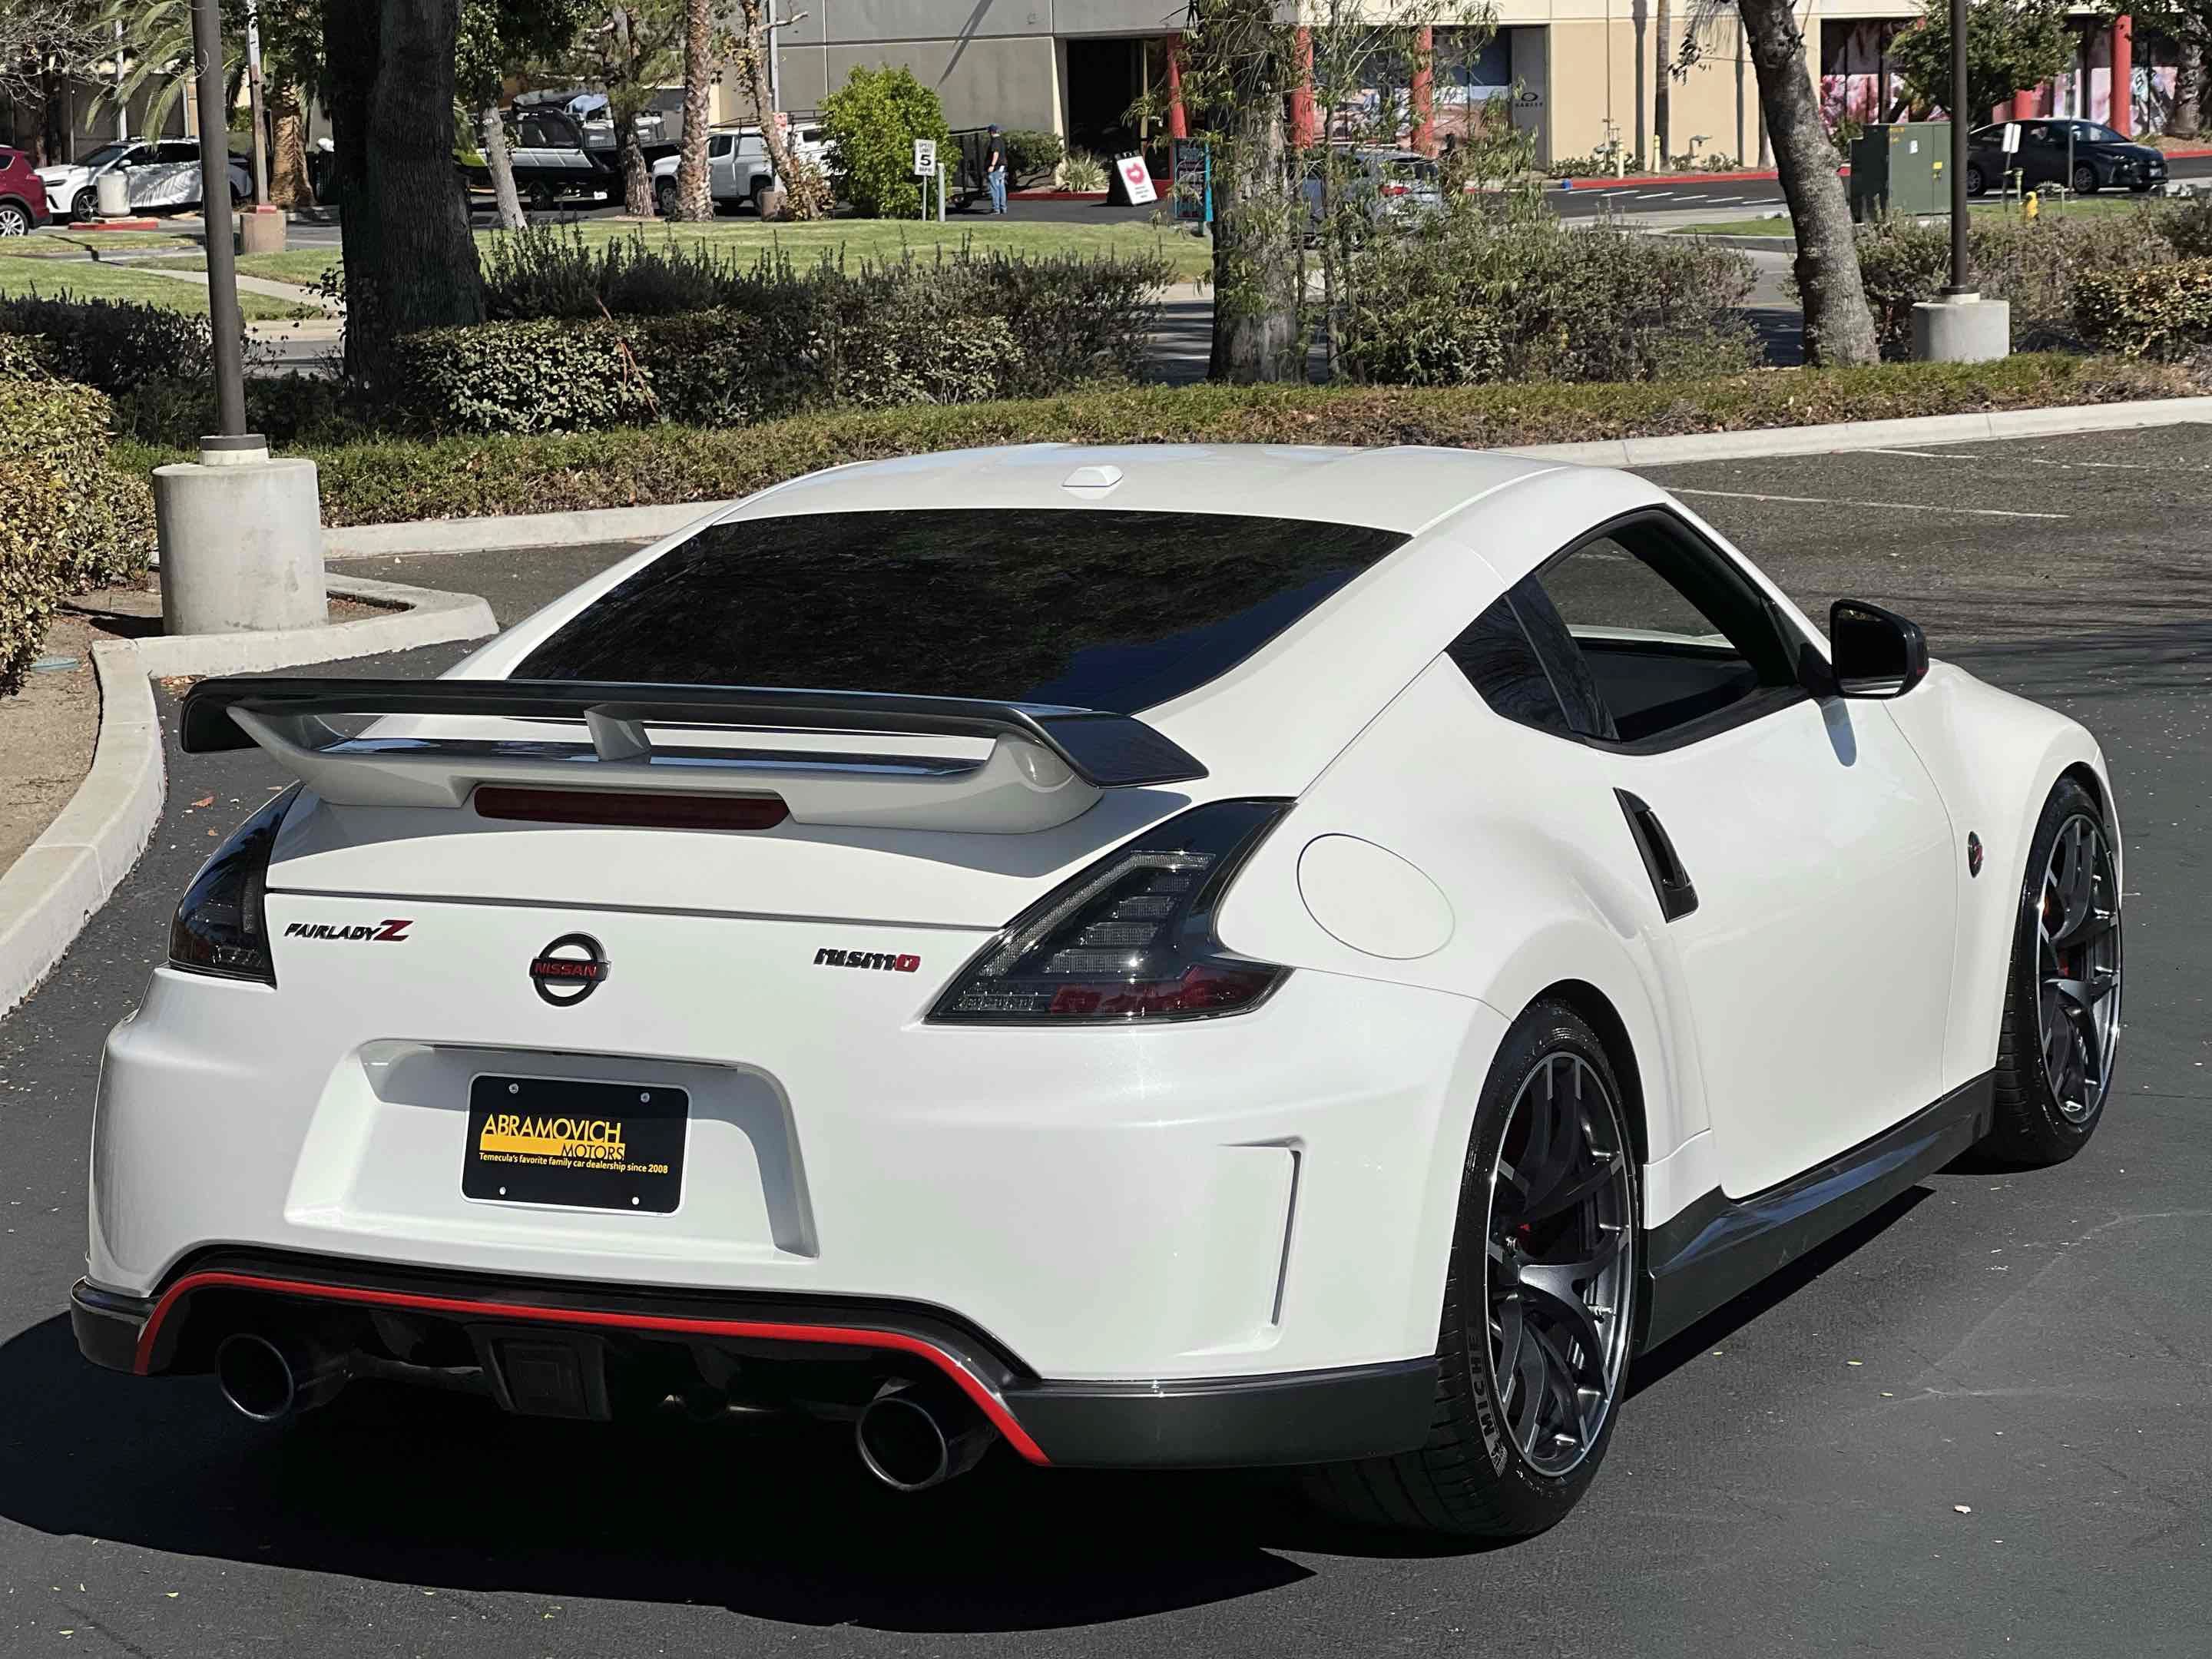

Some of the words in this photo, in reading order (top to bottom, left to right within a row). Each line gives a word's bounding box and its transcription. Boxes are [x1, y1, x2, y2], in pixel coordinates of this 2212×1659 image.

[920, 154, 932, 166] 5
[534, 962, 597, 978] NISSAN
[481, 1114, 621, 1144] ABRAMOVICH
[561, 1143, 624, 1161] MOTORS
[479, 1152, 518, 1163] Temecula's
[519, 1154, 547, 1165] favorite
[548, 1157, 572, 1168] family
[586, 1160, 626, 1173] dealership
[627, 1163, 647, 1172] since
[647, 1164, 668, 1174] 2008
